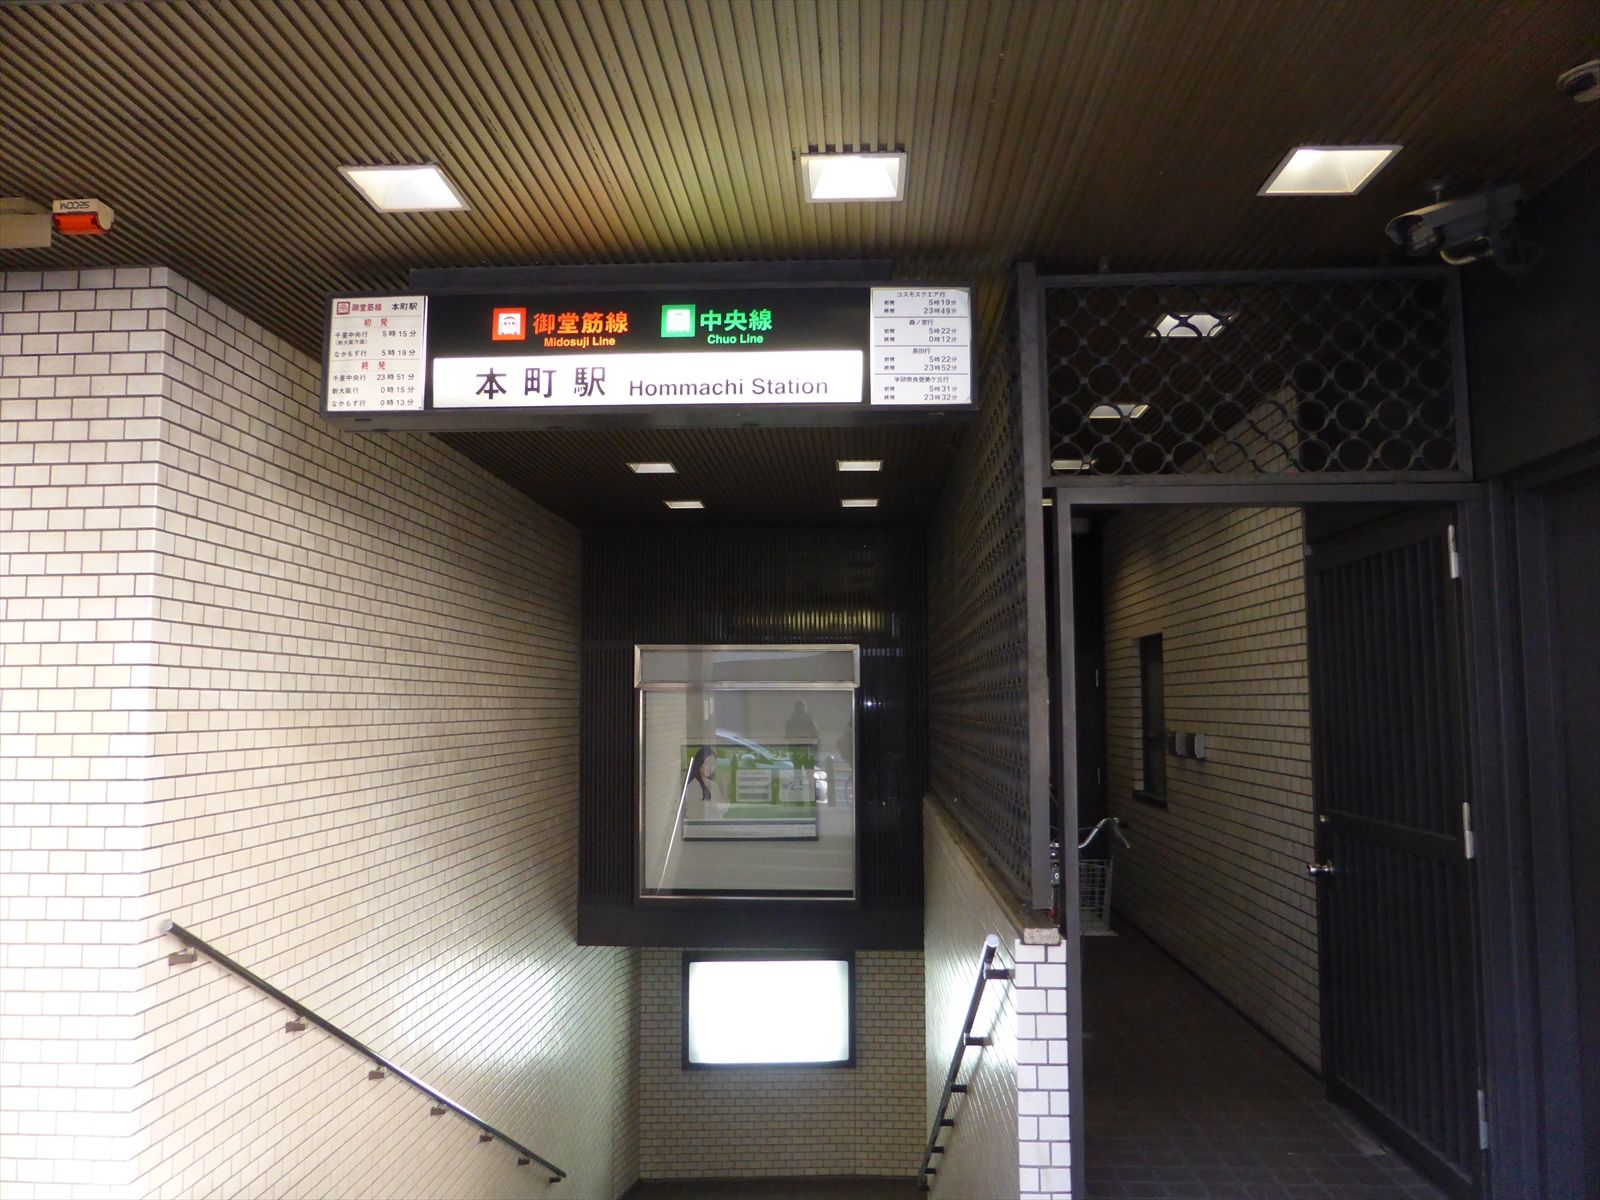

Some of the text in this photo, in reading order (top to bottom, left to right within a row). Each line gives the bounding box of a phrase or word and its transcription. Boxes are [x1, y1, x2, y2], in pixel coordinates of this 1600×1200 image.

[60, 201, 90, 209] SECOM
[533, 311, 628, 334] 御堂筋線
[700, 309, 772, 332] 中央線
[544, 336, 615, 348] Midosuji Line
[707, 333, 763, 345] Chuo Line
[476, 367, 605, 399] 本町駅
[630, 377, 828, 397] Hommachi Station
